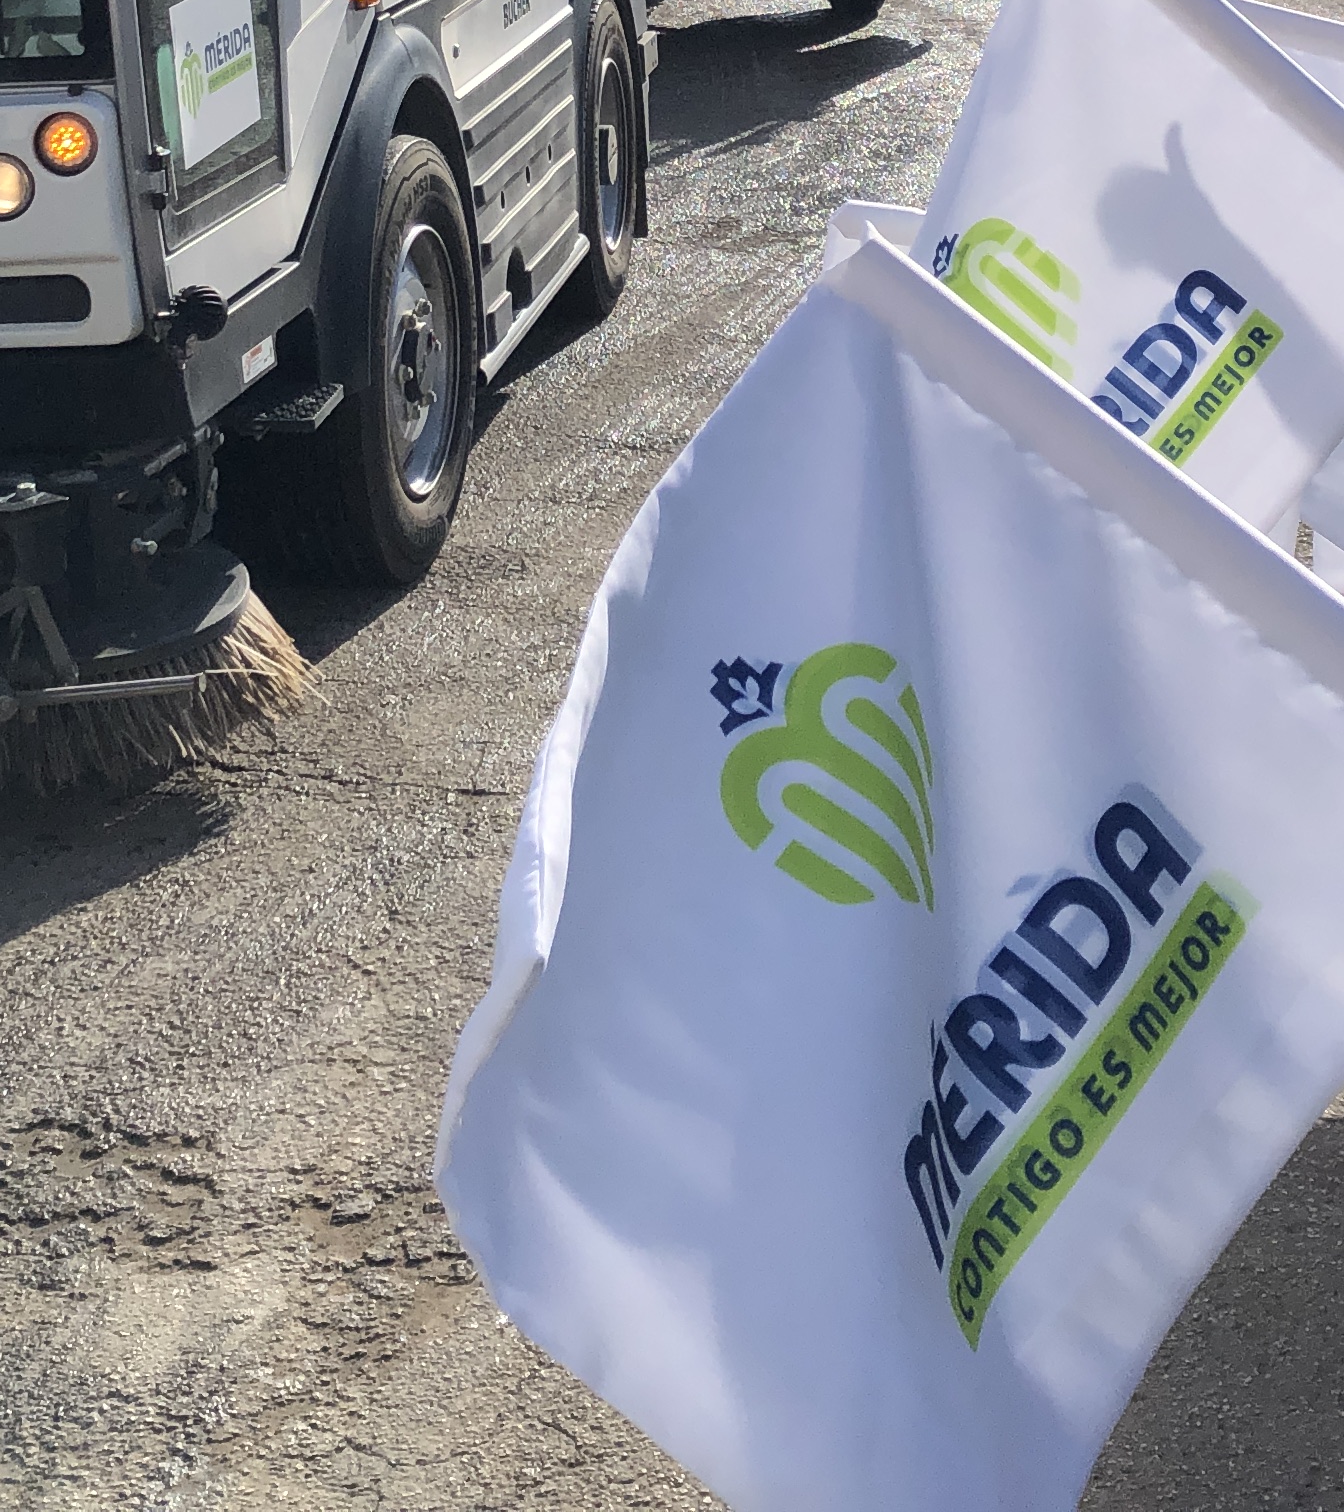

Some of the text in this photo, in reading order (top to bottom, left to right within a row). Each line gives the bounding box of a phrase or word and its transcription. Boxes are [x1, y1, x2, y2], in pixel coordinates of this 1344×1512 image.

[204, 22, 252, 74] MÉRIDA
[1158, 326, 1274, 462] ES MEJOR
[904, 800, 1193, 1274] MÉRIDA
[956, 908, 1232, 1324] CONTIGO ES MEJOR
